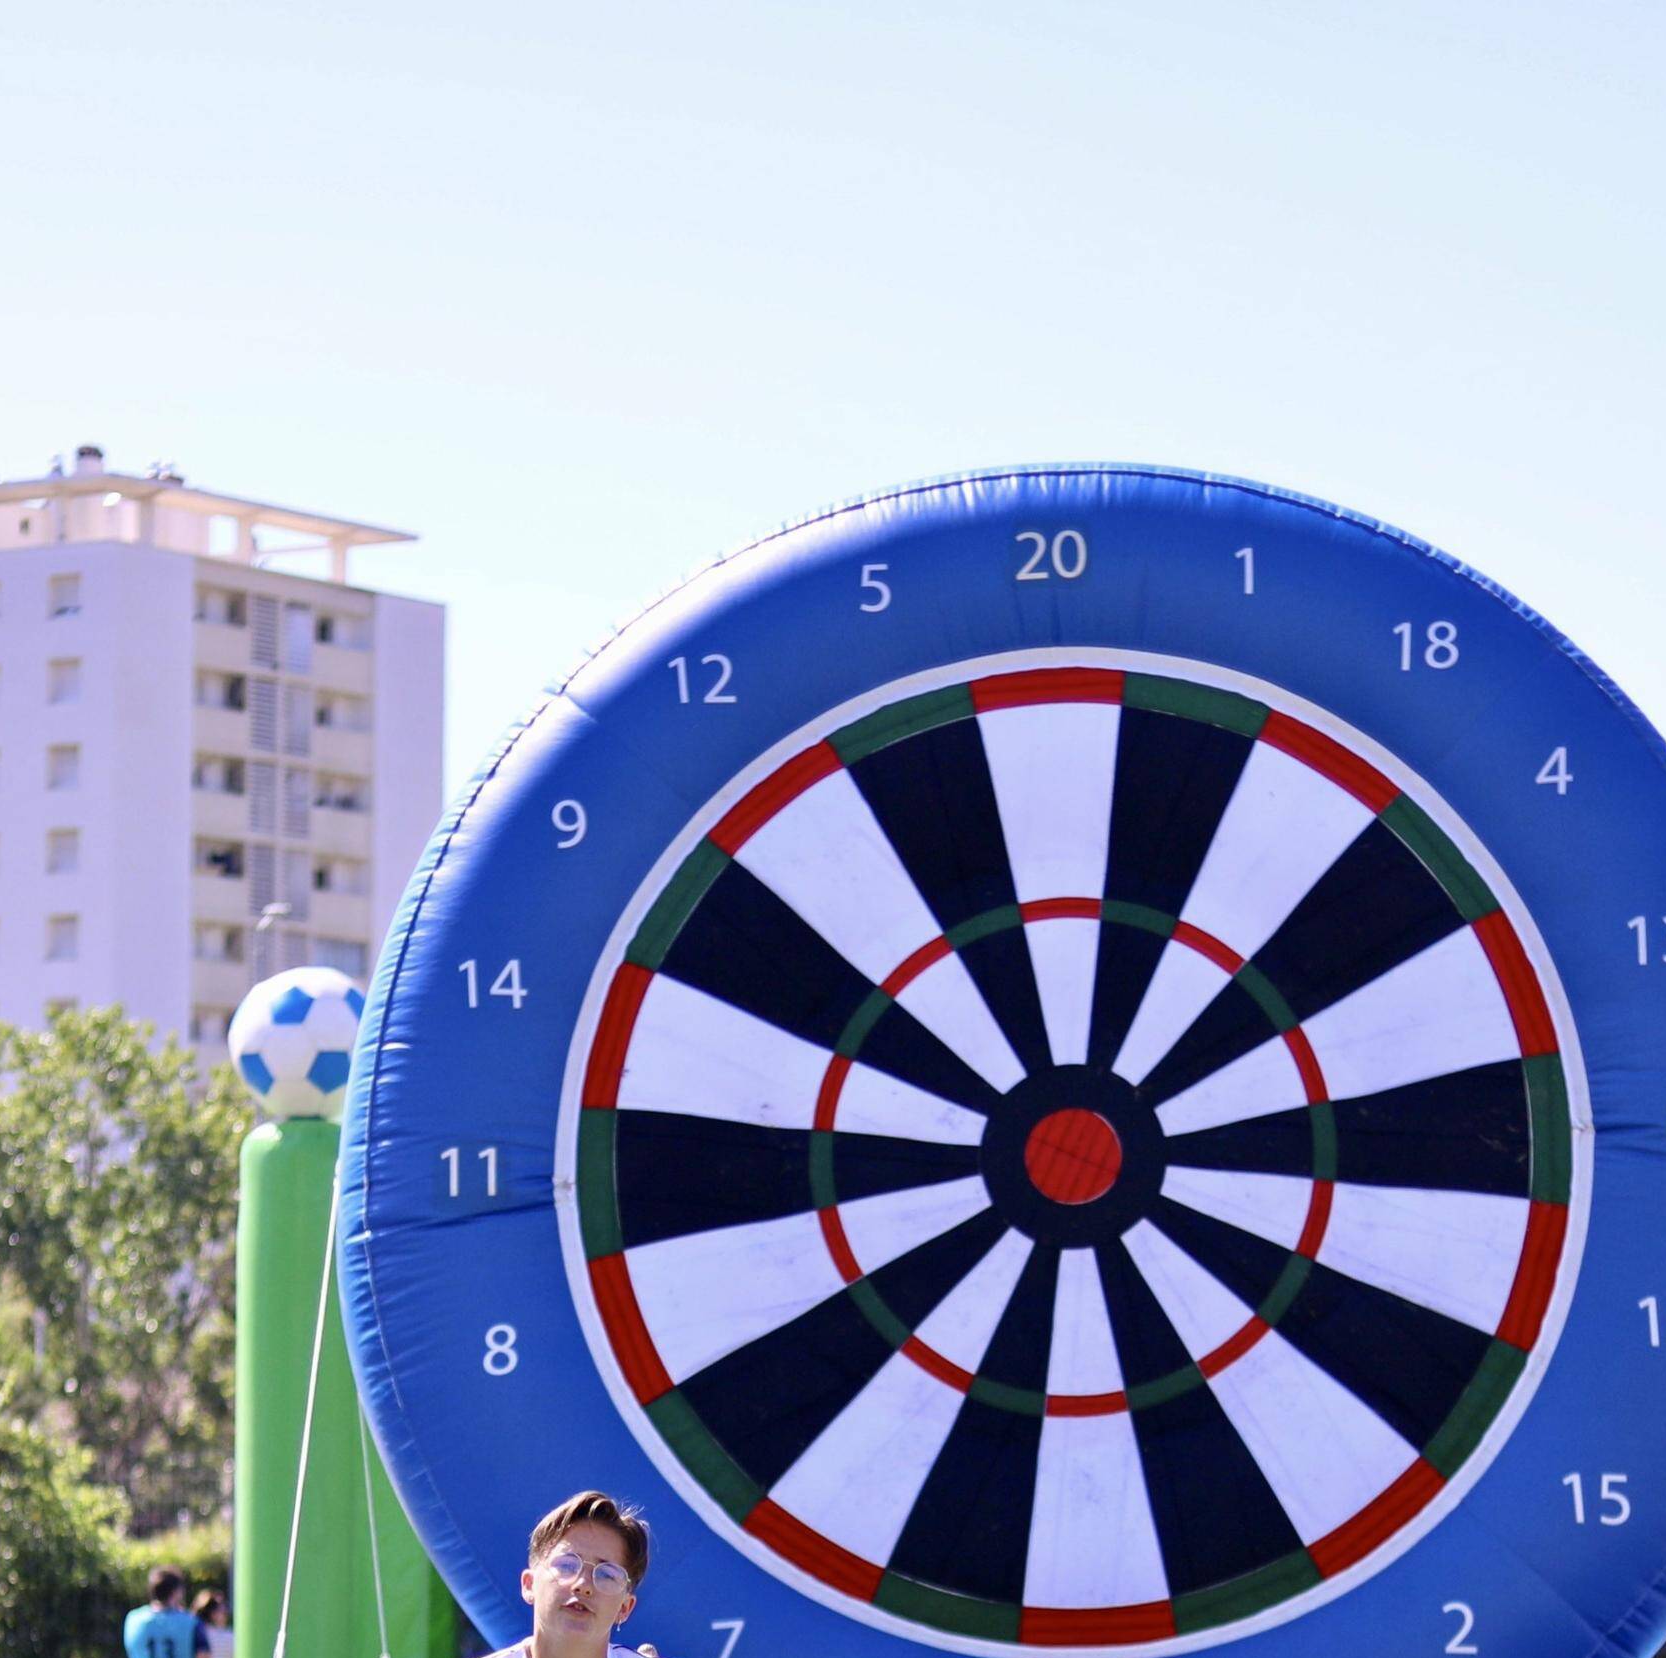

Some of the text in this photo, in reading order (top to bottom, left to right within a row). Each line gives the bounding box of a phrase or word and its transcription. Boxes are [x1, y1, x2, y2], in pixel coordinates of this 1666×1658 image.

[1015, 529, 1087, 581] 20
[1235, 547, 1255, 595] 1
[860, 563, 891, 613] 5
[1392, 620, 1459, 672] 18
[668, 653, 737, 704] 12
[1535, 746, 1574, 795] 4
[551, 799, 587, 849] 9
[458, 959, 528, 1009] 14
[440, 1147, 499, 1197] 11
[482, 1324, 518, 1376] 8
[1562, 1472, 1631, 1526] 15
[1442, 1601, 1478, 1654] 2
